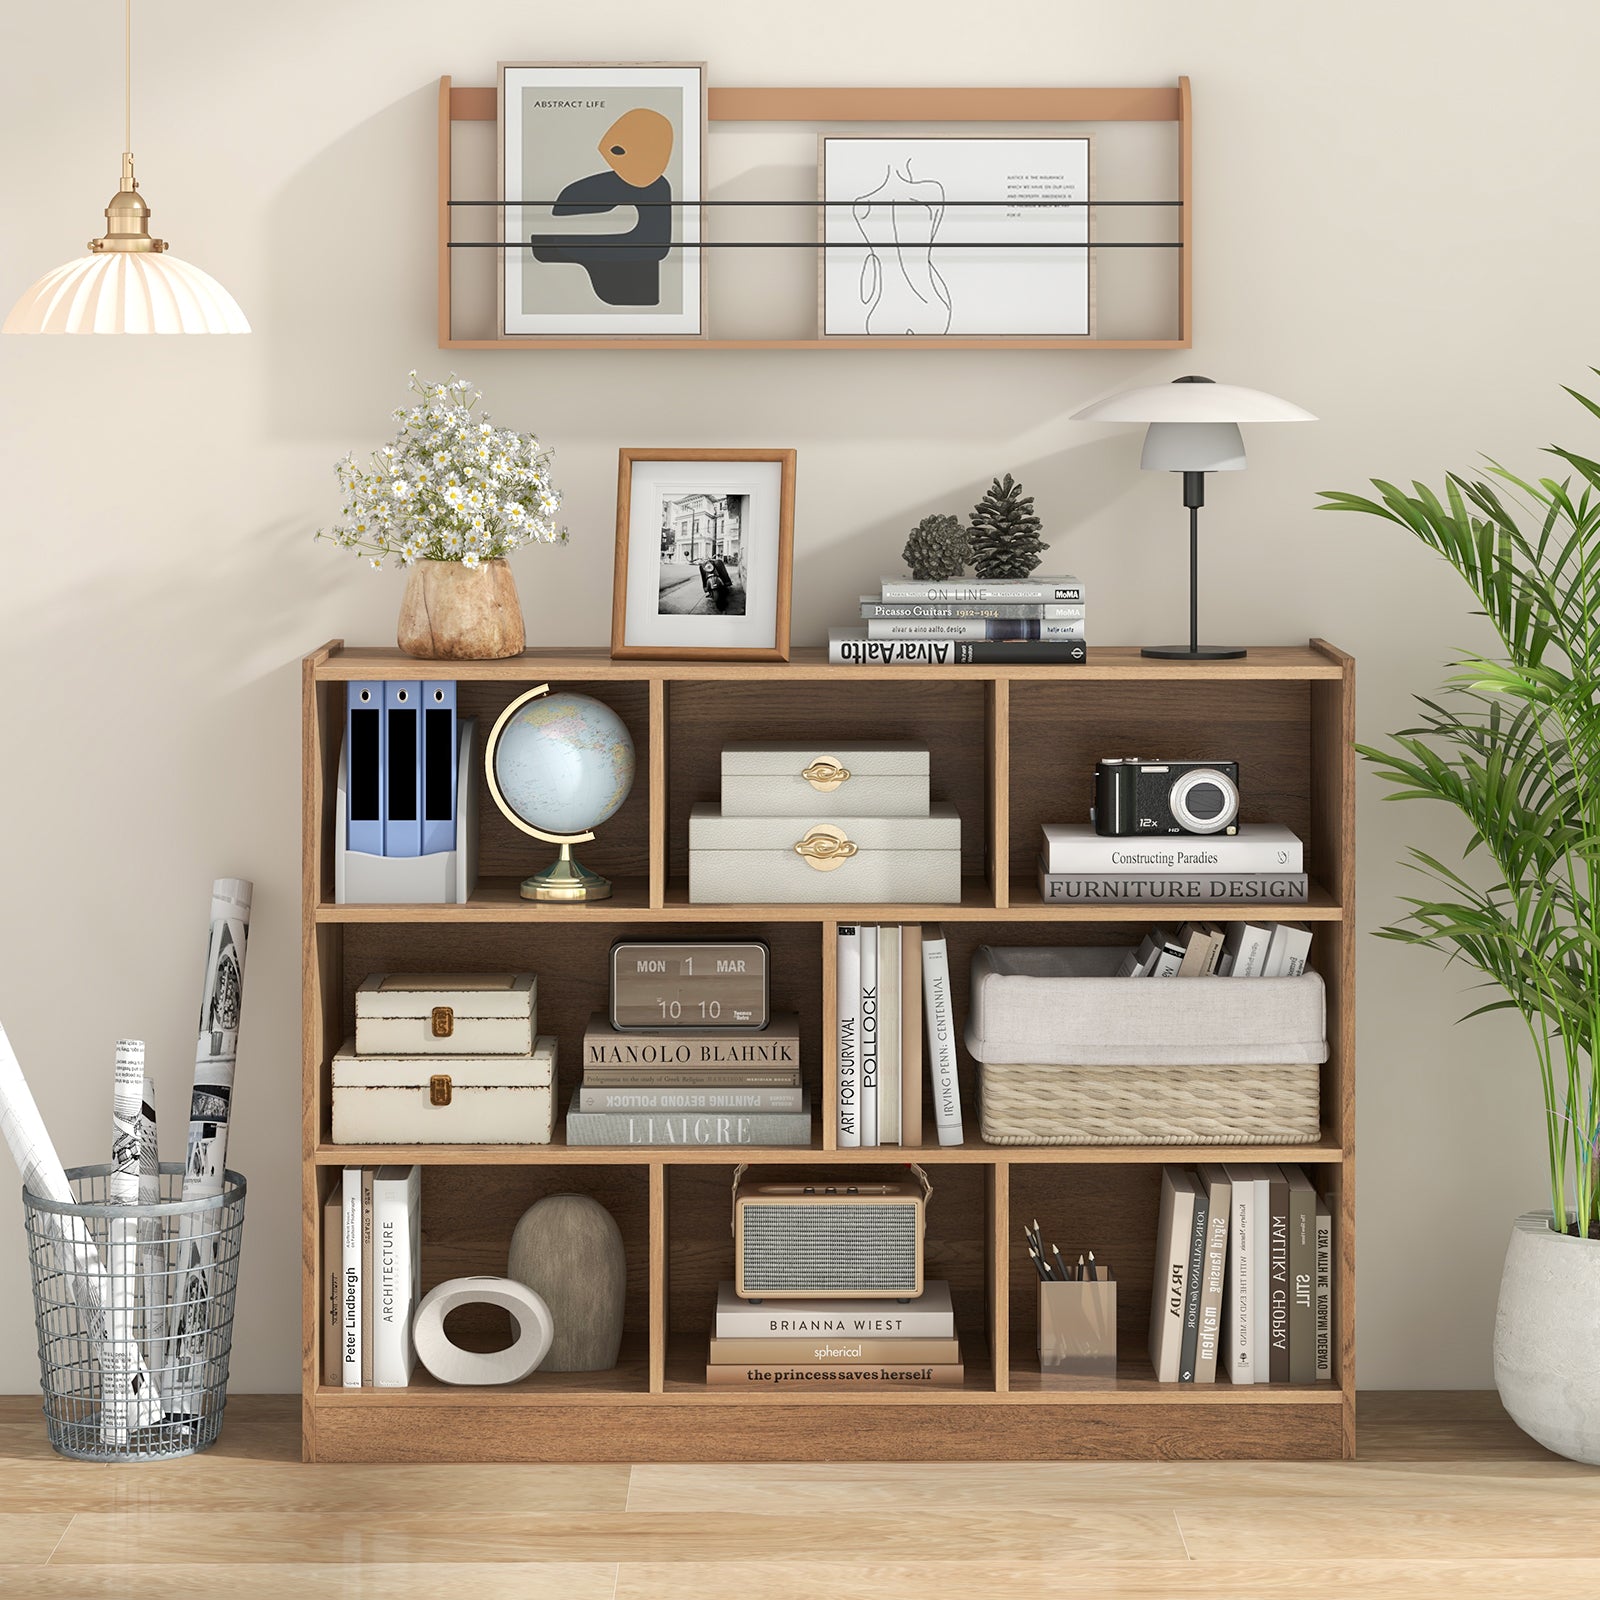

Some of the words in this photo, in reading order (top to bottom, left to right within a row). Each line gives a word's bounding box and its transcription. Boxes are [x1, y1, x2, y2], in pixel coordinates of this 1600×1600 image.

[533, 100, 583, 109] ABSTRACT
[586, 100, 606, 109] LIFE
[927, 588, 948, 601] ON
[954, 588, 987, 601] LINE
[1056, 590, 1079, 598] MoMA
[875, 605, 911, 617] Picasso
[913, 605, 952, 617] Guitars
[946, 626, 966, 635] design
[1139, 818, 1158, 827] 12x
[1111, 851, 1174, 867] Constructing
[1177, 851, 1218, 864] Paradies
[1050, 881, 1201, 898] FURNITURE
[1210, 881, 1305, 898] DESIGN
[636, 960, 666, 972] MON
[684, 957, 693, 975] 1
[716, 960, 746, 972] MAR
[658, 1000, 681, 1019] 10
[698, 1000, 721, 1019] 10
[933, 976, 947, 1041] CENTENNIAL
[863, 986, 877, 1088] POLLOCK
[590, 1045, 691, 1063] MANOLO
[701, 1042, 793, 1062] BLAHNÍK
[841, 1017, 855, 1076] SURVIVAL
[606, 1095, 657, 1107] POLLOCK
[660, 1095, 706, 1107] BEYOND
[709, 1095, 761, 1107] PAINTING
[841, 1079, 855, 1107] FOR
[941, 1078, 954, 1117] IRVING
[629, 1118, 751, 1144] LIAIGRE
[841, 1111, 855, 1134] ART
[383, 1221, 393, 1323] ARCHITECTURE
[345, 1267, 358, 1328] Lindbergh
[769, 1320, 846, 1331] BRIANNA
[854, 1320, 902, 1331] WIEST
[345, 1329, 356, 1363] Peter
[814, 1345, 862, 1360] spherical
[747, 1369, 772, 1381] the
[774, 1369, 837, 1383] princess
[838, 1371, 879, 1380] saves
[880, 1369, 933, 1381] herself
